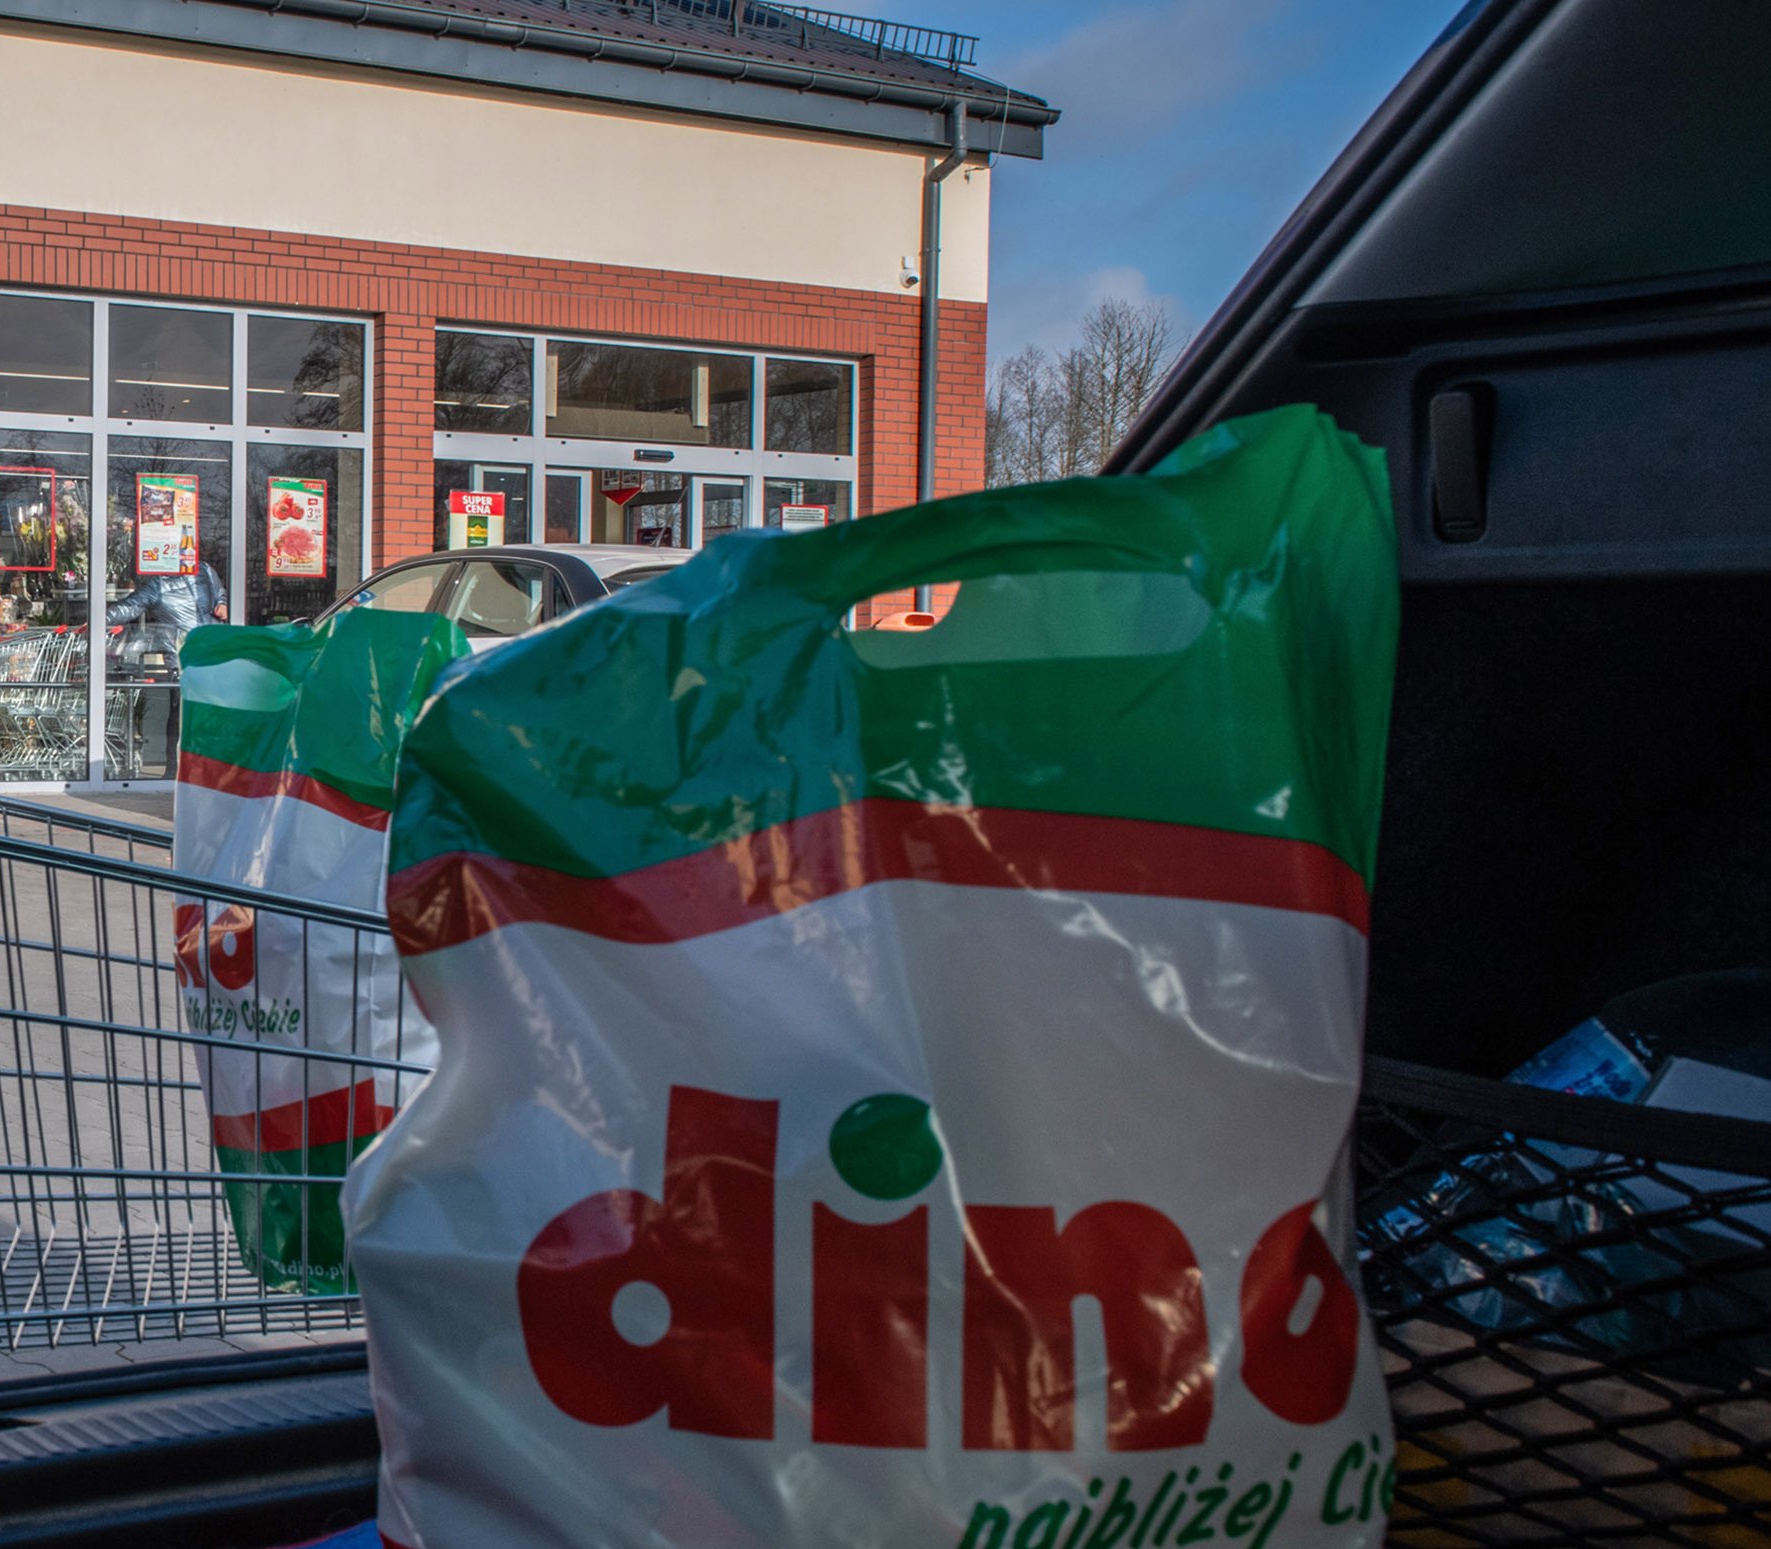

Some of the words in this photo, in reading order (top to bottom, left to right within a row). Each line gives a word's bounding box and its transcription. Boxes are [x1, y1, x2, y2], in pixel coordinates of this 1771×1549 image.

[462, 495, 493, 506] SUPER
[465, 504, 492, 515] CENA
[241, 998, 300, 1034] Ciebie
[517, 1085, 1359, 1452] dino
